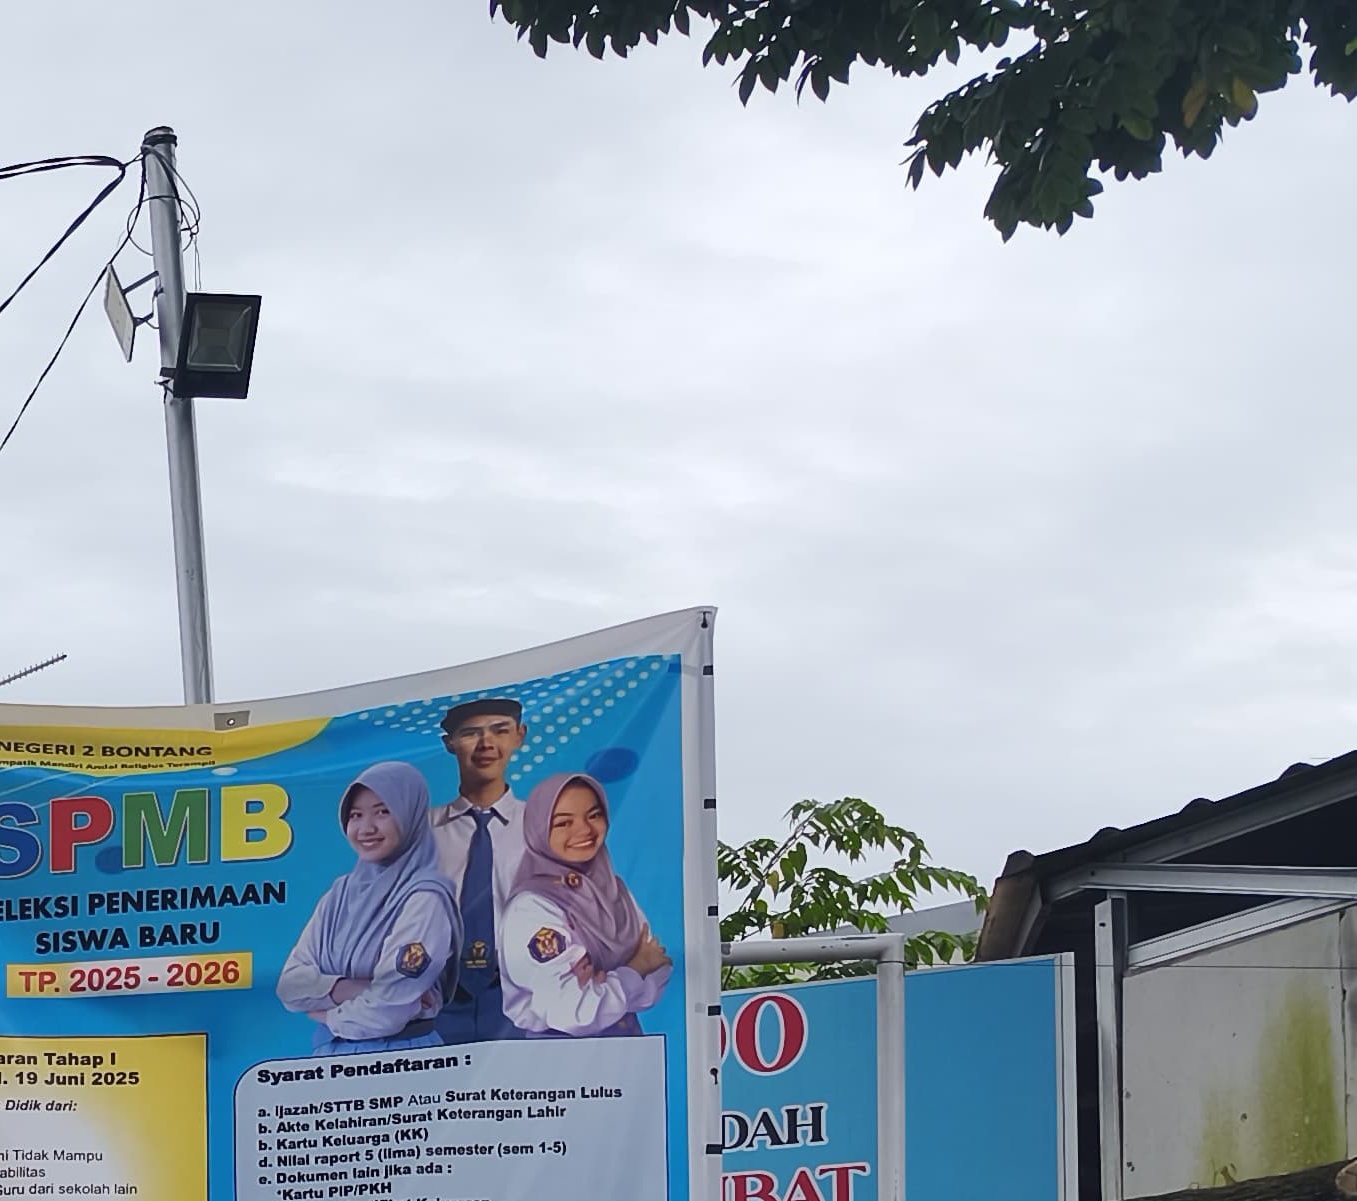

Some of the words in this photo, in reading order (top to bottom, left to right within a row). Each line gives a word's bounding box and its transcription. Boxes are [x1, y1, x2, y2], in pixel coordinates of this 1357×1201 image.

[83, 745, 95, 756] 2
[101, 745, 212, 757] BONTANG
[88, 881, 286, 916] PENERIMAAN
[36, 928, 128, 954] SISWA
[139, 921, 219, 948] BARU
[18, 971, 60, 994] TP.
[69, 965, 141, 992] 2025
[166, 960, 239, 986] 2026
[44, 1053, 104, 1068] Tahap
[111, 1053, 115, 1065] I
[258, 1065, 325, 1085] Syarat
[330, 1054, 458, 1079] Pendaftaran
[16, 1072, 37, 1085] 19
[44, 1072, 85, 1086] Juni
[92, 1072, 139, 1086] 2025
[6, 1099, 41, 1112] Didik
[45, 1100, 77, 1112] dari:
[258, 1107, 270, 1117] a.
[275, 1097, 365, 1118] Ijazah/STTB
[369, 1096, 403, 1109] SMP
[408, 1093, 441, 1107] Atau
[445, 1089, 486, 1102] Surat
[490, 1086, 576, 1102] Keterangan
[581, 1086, 622, 1098] Lulus
[13, 1149, 49, 1162] Tidak
[53, 1149, 103, 1164] Mampu
